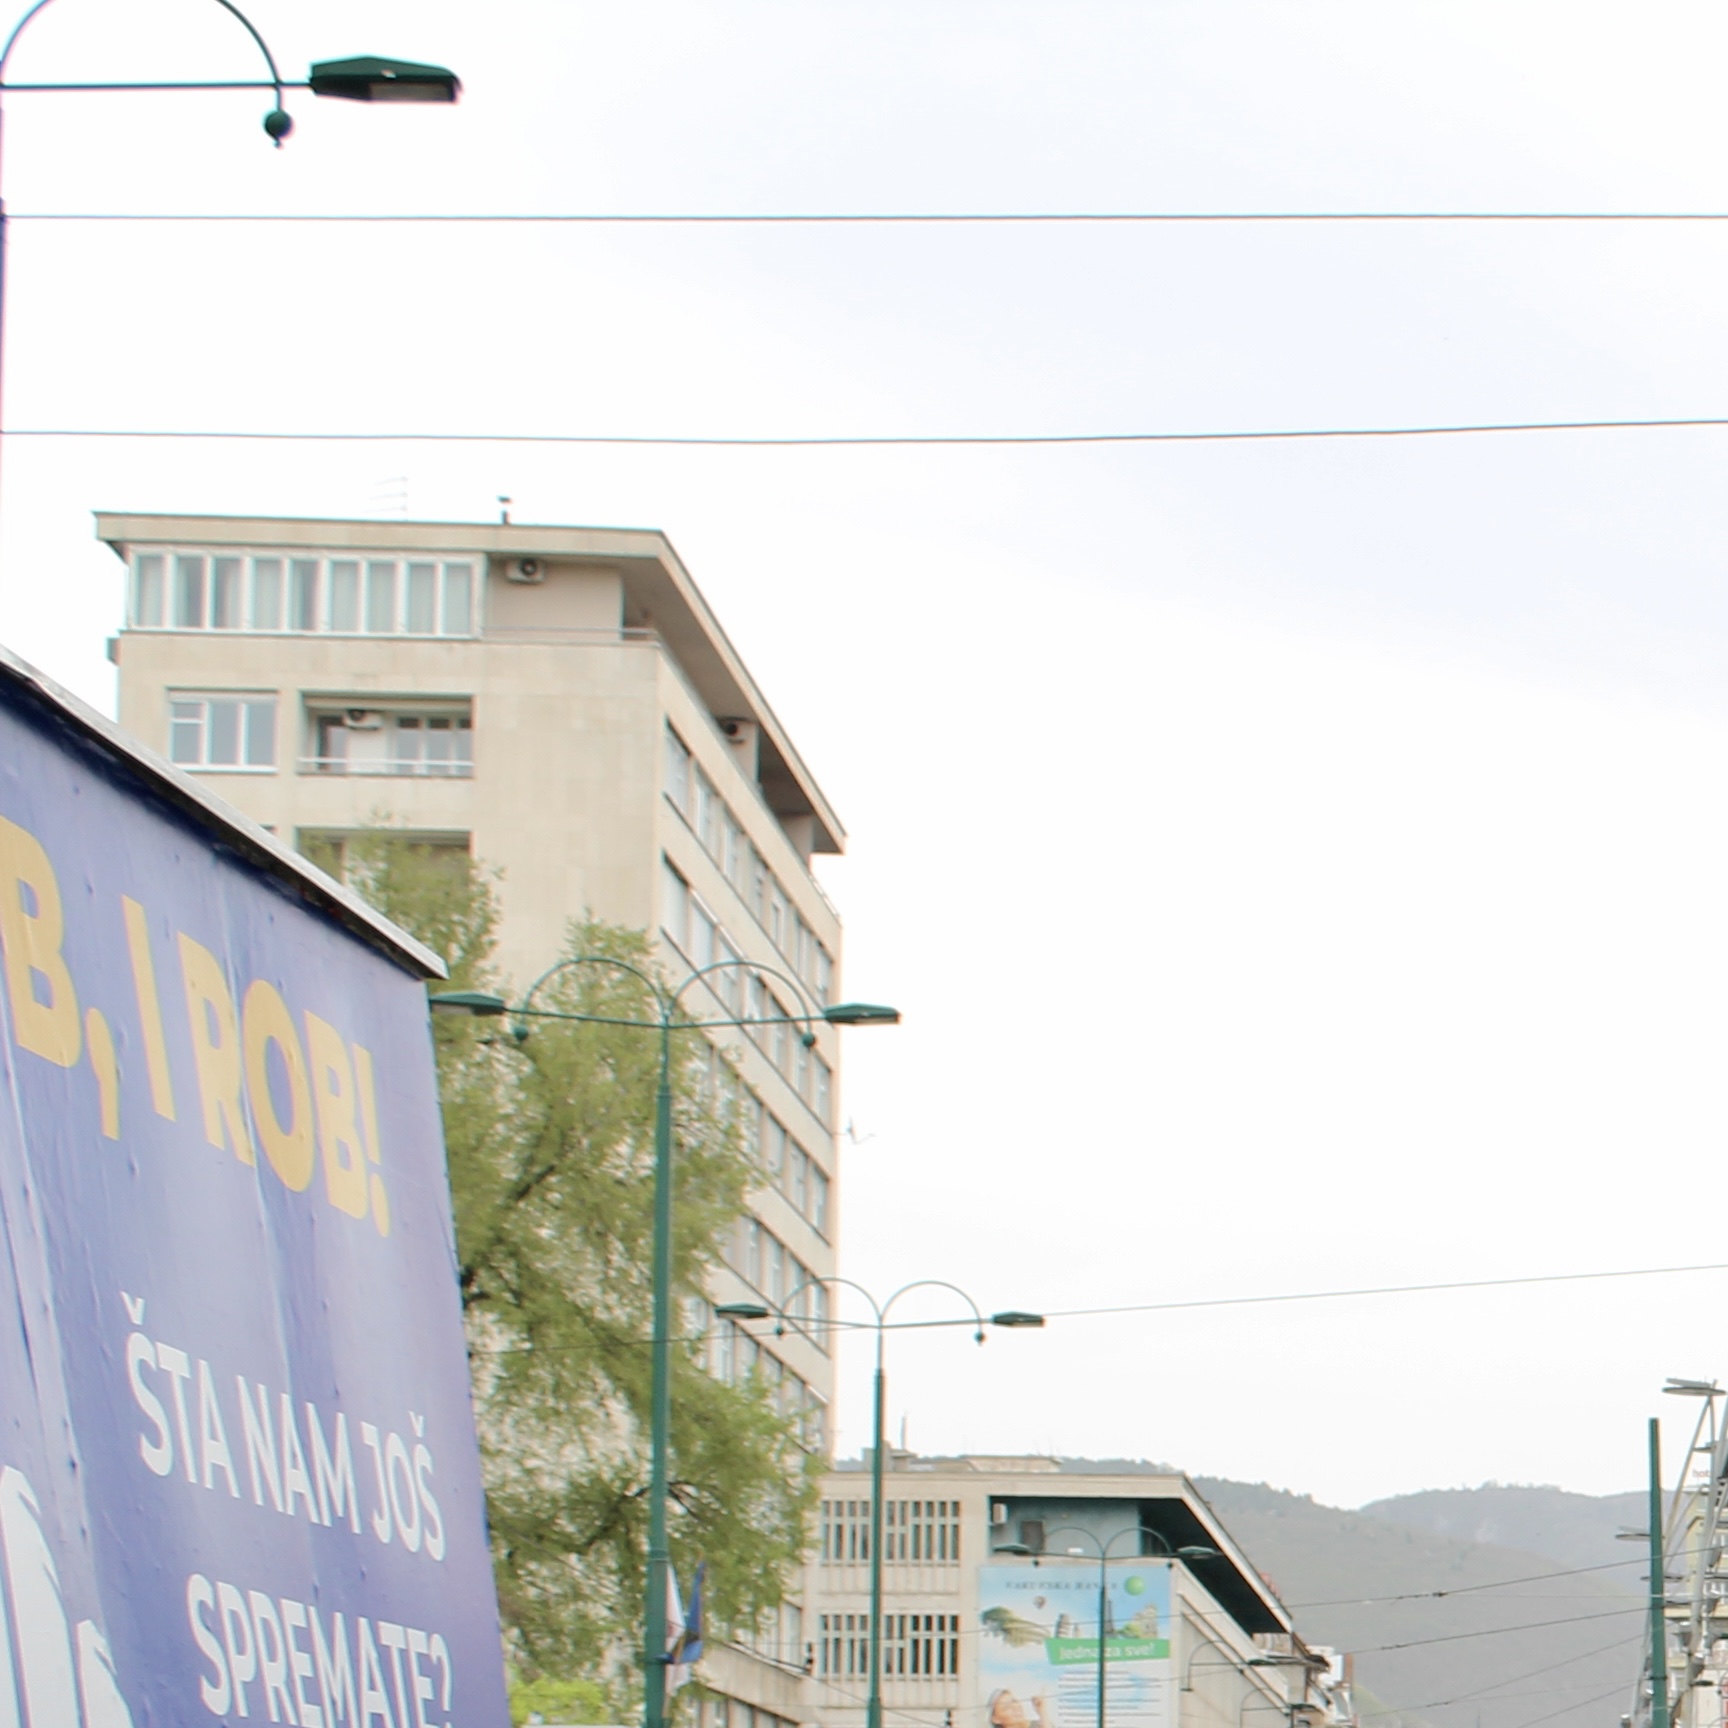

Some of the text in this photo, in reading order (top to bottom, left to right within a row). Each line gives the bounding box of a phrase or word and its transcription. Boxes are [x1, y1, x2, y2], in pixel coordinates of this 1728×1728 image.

[122, 892, 176, 1123] I
[177, 928, 391, 1239] ROB!
[119, 1290, 447, 1563] ŠTA NAM JOŠ
